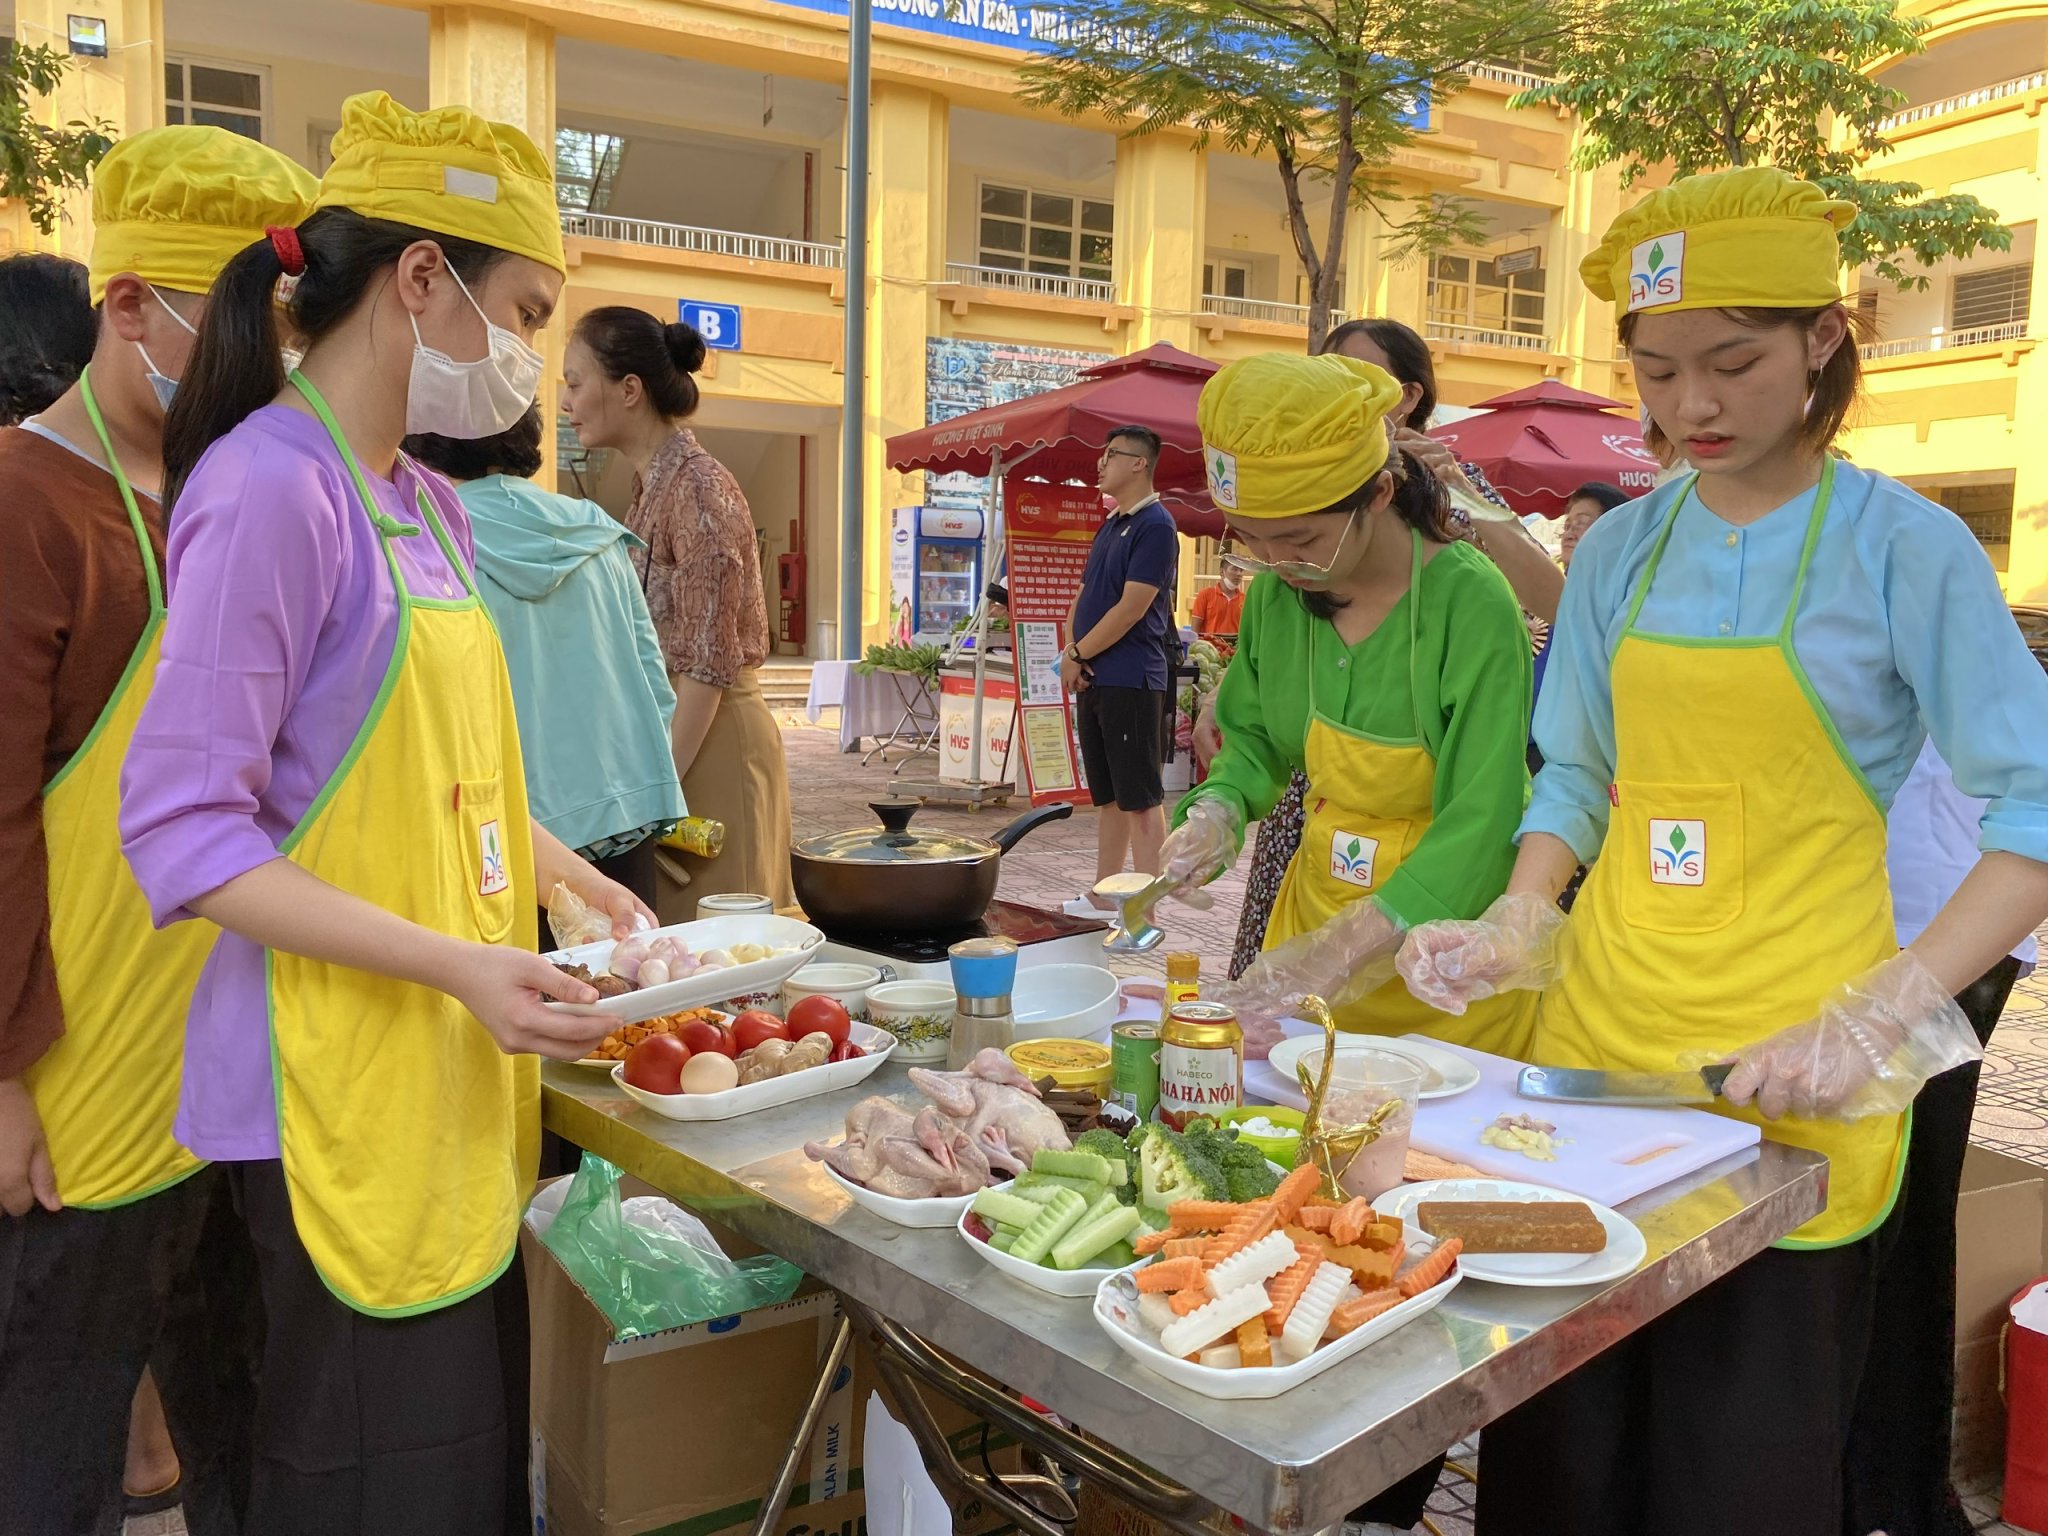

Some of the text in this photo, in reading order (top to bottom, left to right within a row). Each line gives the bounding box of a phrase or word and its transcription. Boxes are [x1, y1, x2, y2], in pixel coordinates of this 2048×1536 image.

[699, 309, 721, 340] B
[1021, 505, 1040, 515] HVS
[944, 522, 963, 530] HVS
[950, 733, 1009, 754] HVS HVS
[1176, 1069, 1213, 1080] HABECO
[1180, 1082, 1207, 1105] HÀ
[1207, 1082, 1235, 1106] NỘI
[826, 1422, 840, 1458] MILK
